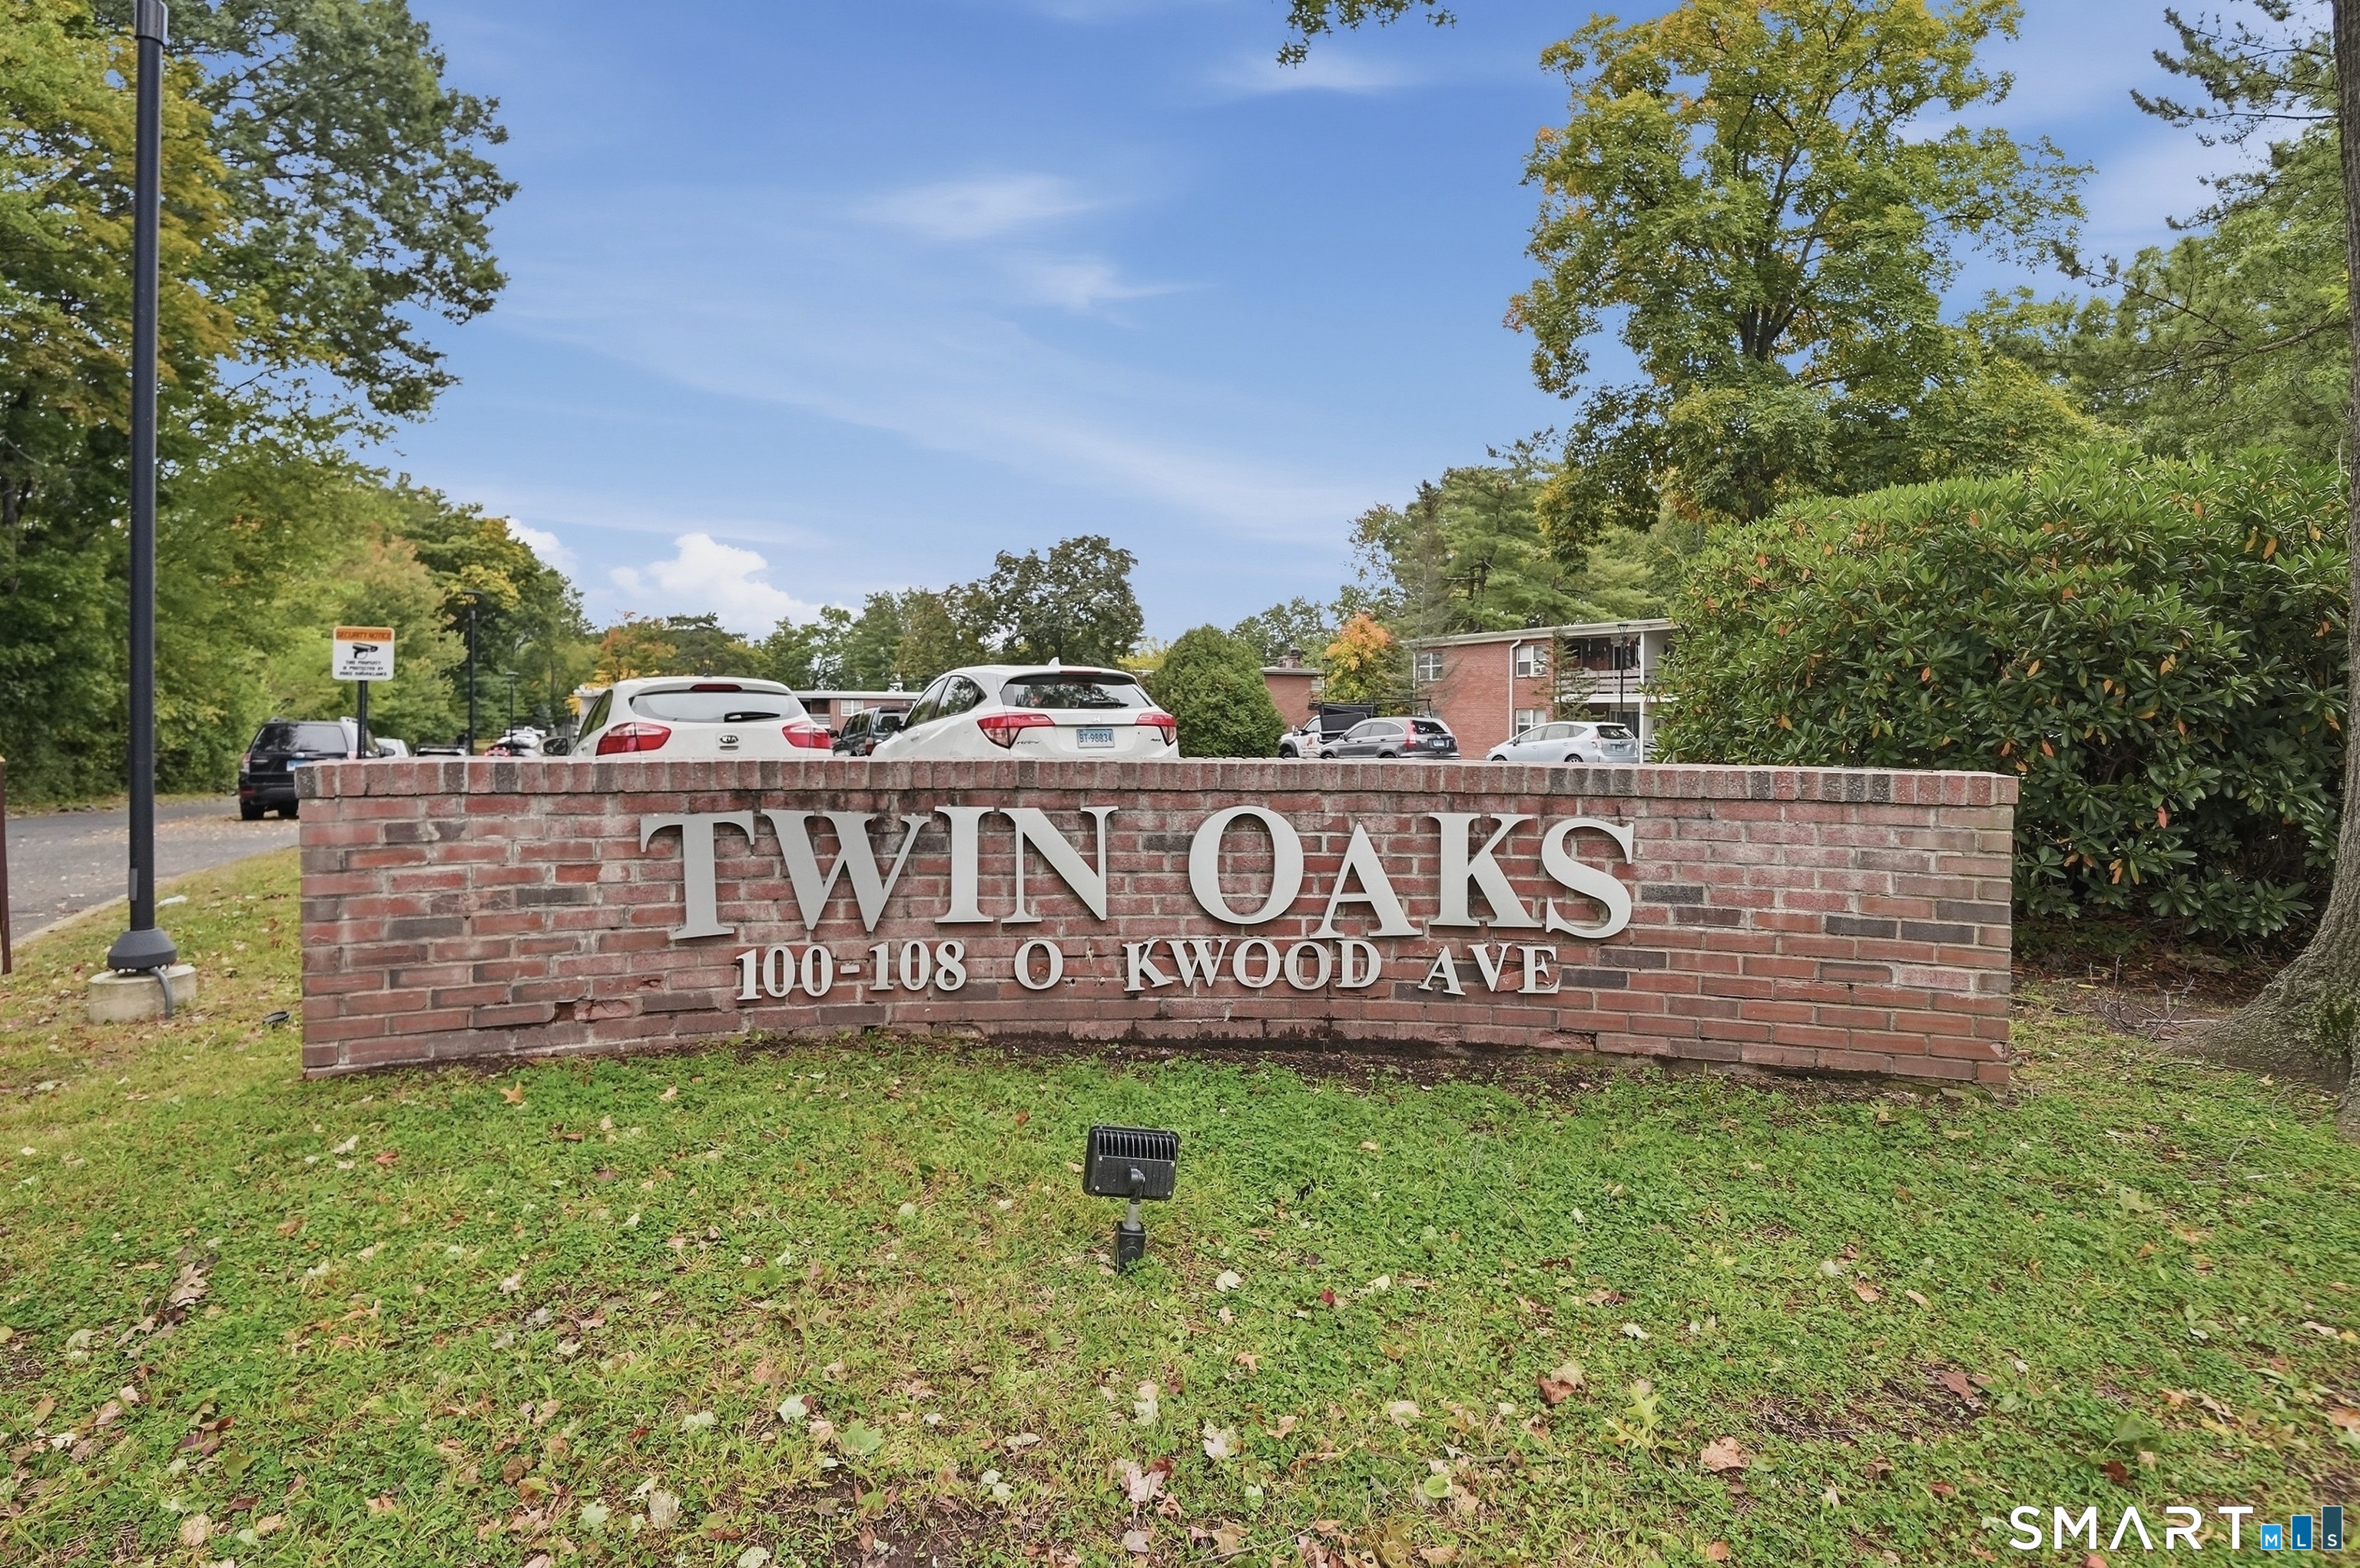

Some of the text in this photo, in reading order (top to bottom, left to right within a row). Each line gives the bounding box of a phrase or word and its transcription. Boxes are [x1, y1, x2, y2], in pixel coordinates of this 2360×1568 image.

[640, 805, 1635, 940] TWIN OAKS
[735, 940, 966, 1000] 100-108
[1418, 943, 1560, 996] AVE
